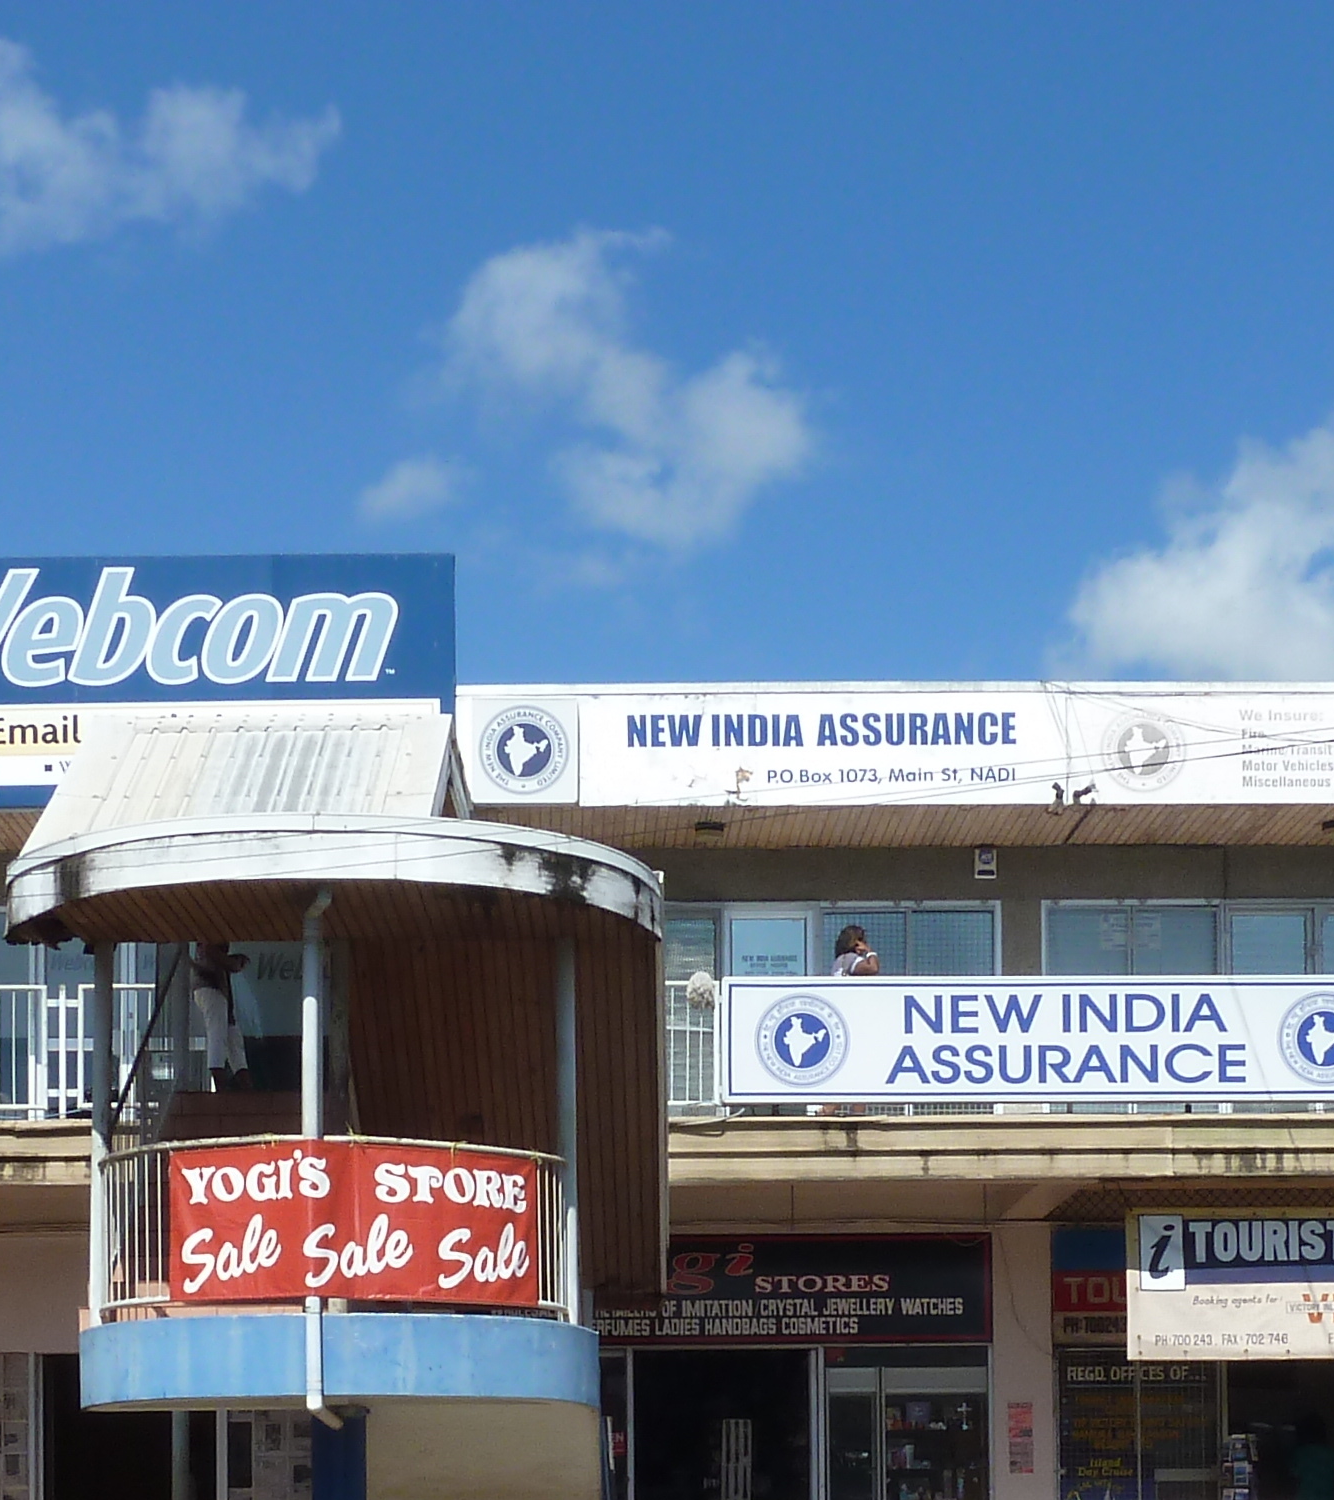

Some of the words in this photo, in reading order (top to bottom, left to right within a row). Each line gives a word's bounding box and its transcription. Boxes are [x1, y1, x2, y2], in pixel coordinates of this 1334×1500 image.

[1239, 709, 1264, 722] We
[485, 728, 497, 752] INDIA
[496, 711, 544, 728] ASSURANCE
[545, 720, 564, 759] COMPANY
[626, 713, 705, 748] NEW
[711, 713, 805, 748] INDIA
[816, 711, 1018, 747] ASSURANCE
[838, 768, 884, 786] 1073,
[888, 768, 934, 784] Main
[939, 767, 963, 785] St,
[969, 766, 1018, 784] NADI
[1241, 759, 1280, 773] Motor
[1282, 759, 1334, 773] Vehicles
[1241, 775, 1333, 790] Miscellaneous
[904, 993, 1043, 1035] NEW
[1062, 993, 1229, 1034] INDIA
[884, 1043, 1247, 1085] ASSURANCE
[180, 1148, 332, 1205] YOGI'S
[373, 1162, 527, 1214] STORE
[180, 1213, 282, 1295] Sale
[301, 1212, 415, 1289] Sale
[437, 1221, 530, 1289] Sale
[753, 1273, 891, 1295] STORES
[661, 1300, 679, 1317] OF
[680, 1297, 819, 1319] IMITATION/CRYSTAL
[822, 1297, 896, 1317] JEWELLERY
[900, 1296, 965, 1317] WATCHES
[1192, 1294, 1229, 1309] Booking
[1231, 1296, 1264, 1309] agents
[593, 1318, 651, 1338] ERFUMES
[655, 1317, 702, 1337] LADIES
[704, 1317, 778, 1337] HANDBAGS
[780, 1316, 860, 1337] COSMETICS
[1110, 1365, 1166, 1381] OFFCES
